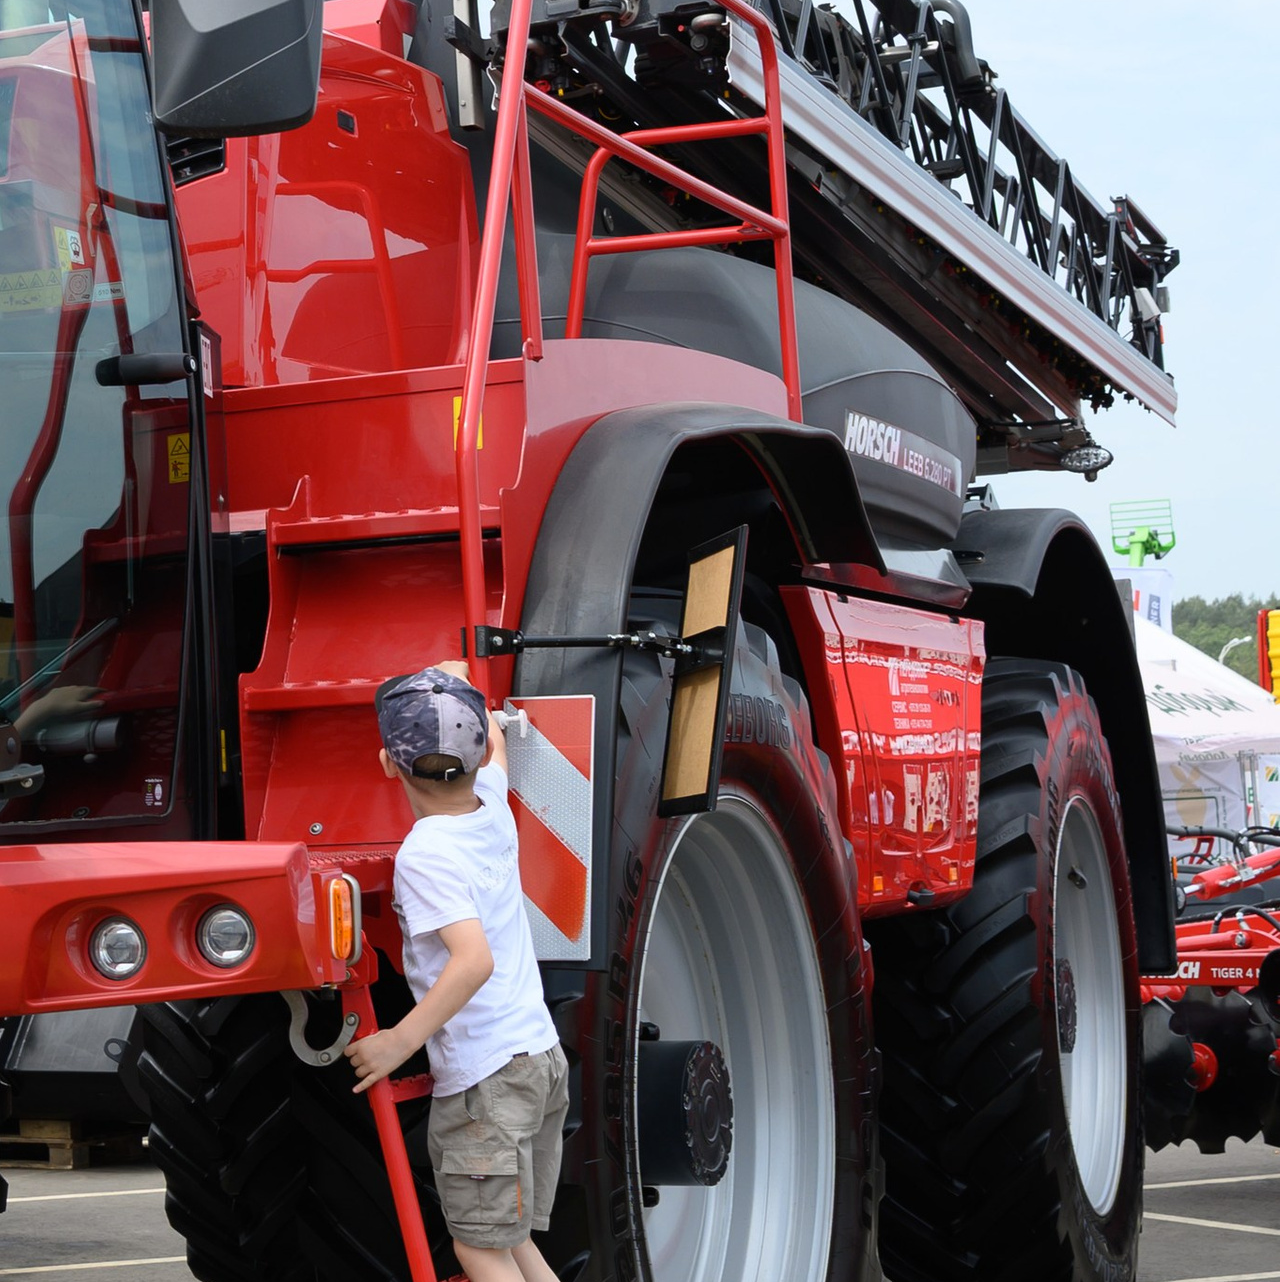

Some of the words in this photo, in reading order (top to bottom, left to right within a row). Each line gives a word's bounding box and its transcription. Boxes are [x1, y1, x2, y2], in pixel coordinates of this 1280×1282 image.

[844, 412, 902, 466] HORSCH
[903, 447, 924, 477] LEEB
[943, 467, 952, 489] PT
[1210, 967, 1244, 979] TIGER
[1245, 967, 1253, 978] 4
